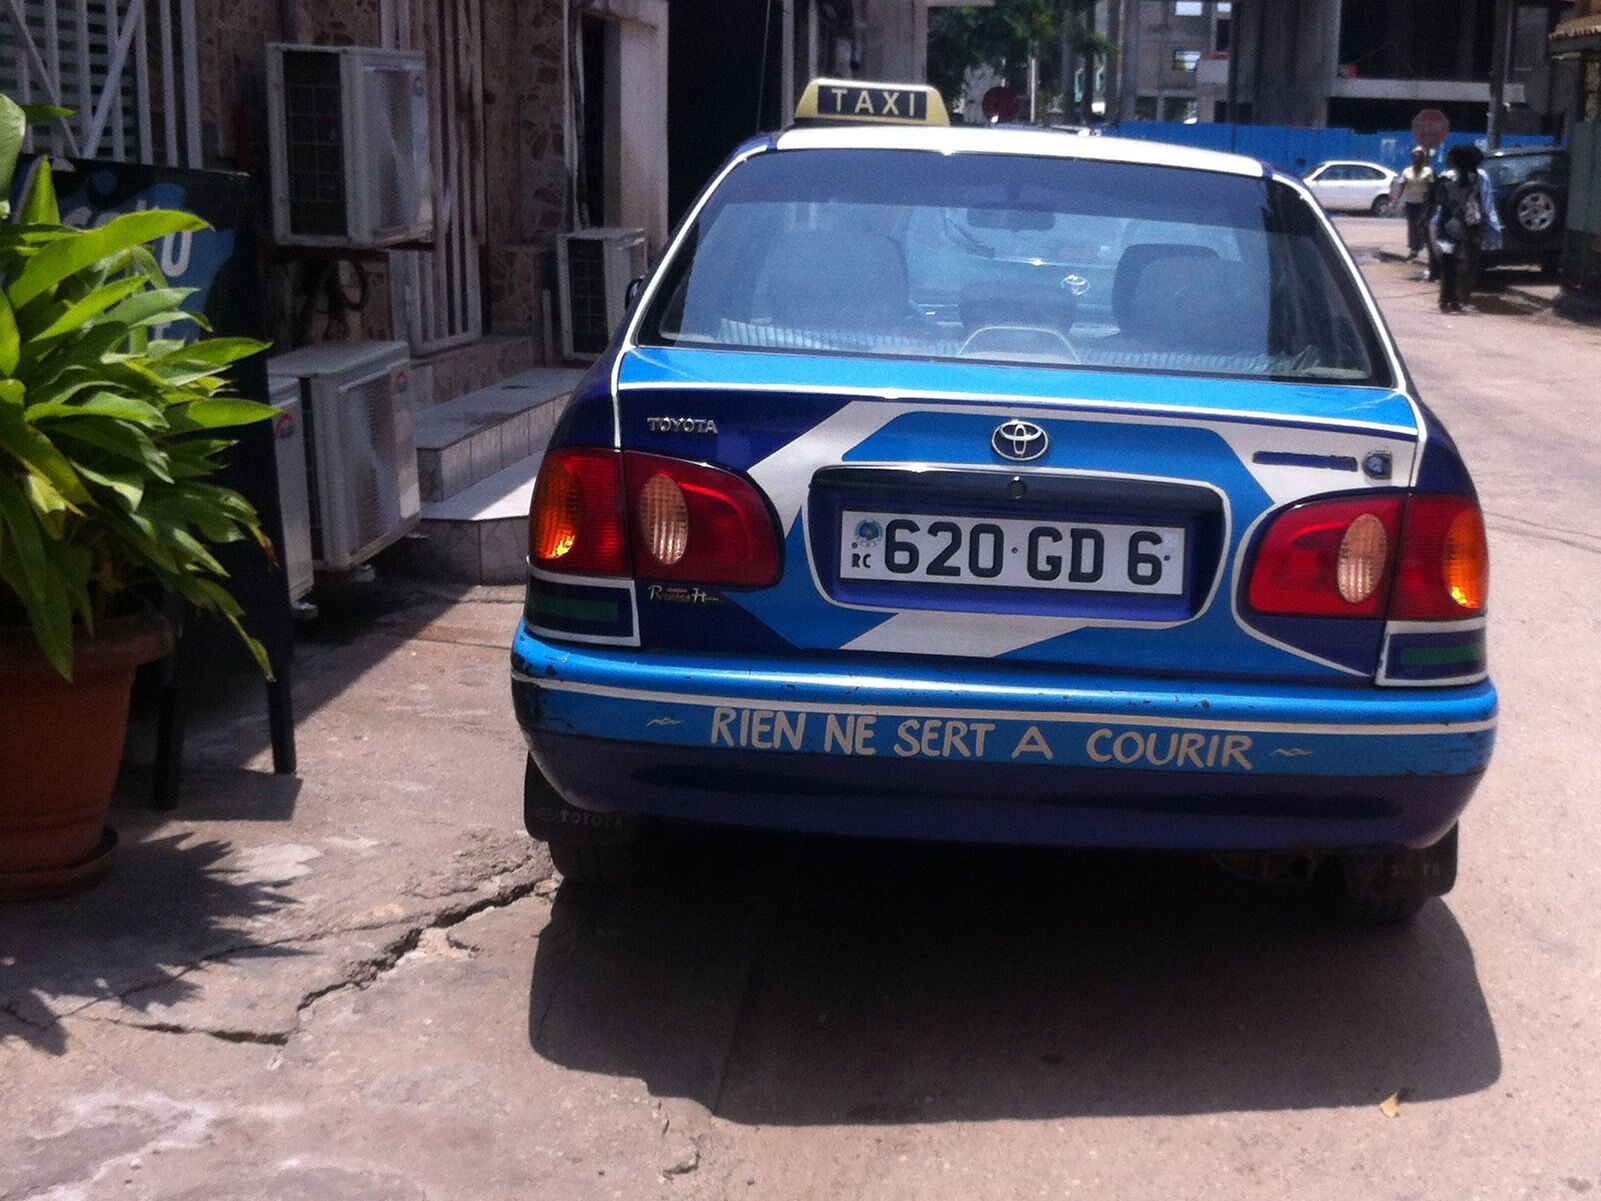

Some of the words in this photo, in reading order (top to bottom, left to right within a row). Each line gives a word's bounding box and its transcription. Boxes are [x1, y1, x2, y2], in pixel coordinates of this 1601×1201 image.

[831, 88, 915, 117] TAXI
[646, 417, 719, 434] TOYOTA
[851, 553, 872, 569] RC
[884, 518, 1005, 578] 620
[1027, 526, 1105, 583] GD
[1127, 530, 1163, 586] 6
[711, 706, 806, 750] RIEN
[824, 713, 878, 756] NE
[893, 719, 996, 758] SERT
[1011, 726, 1053, 760] A
[1086, 728, 1254, 771] COURIR
